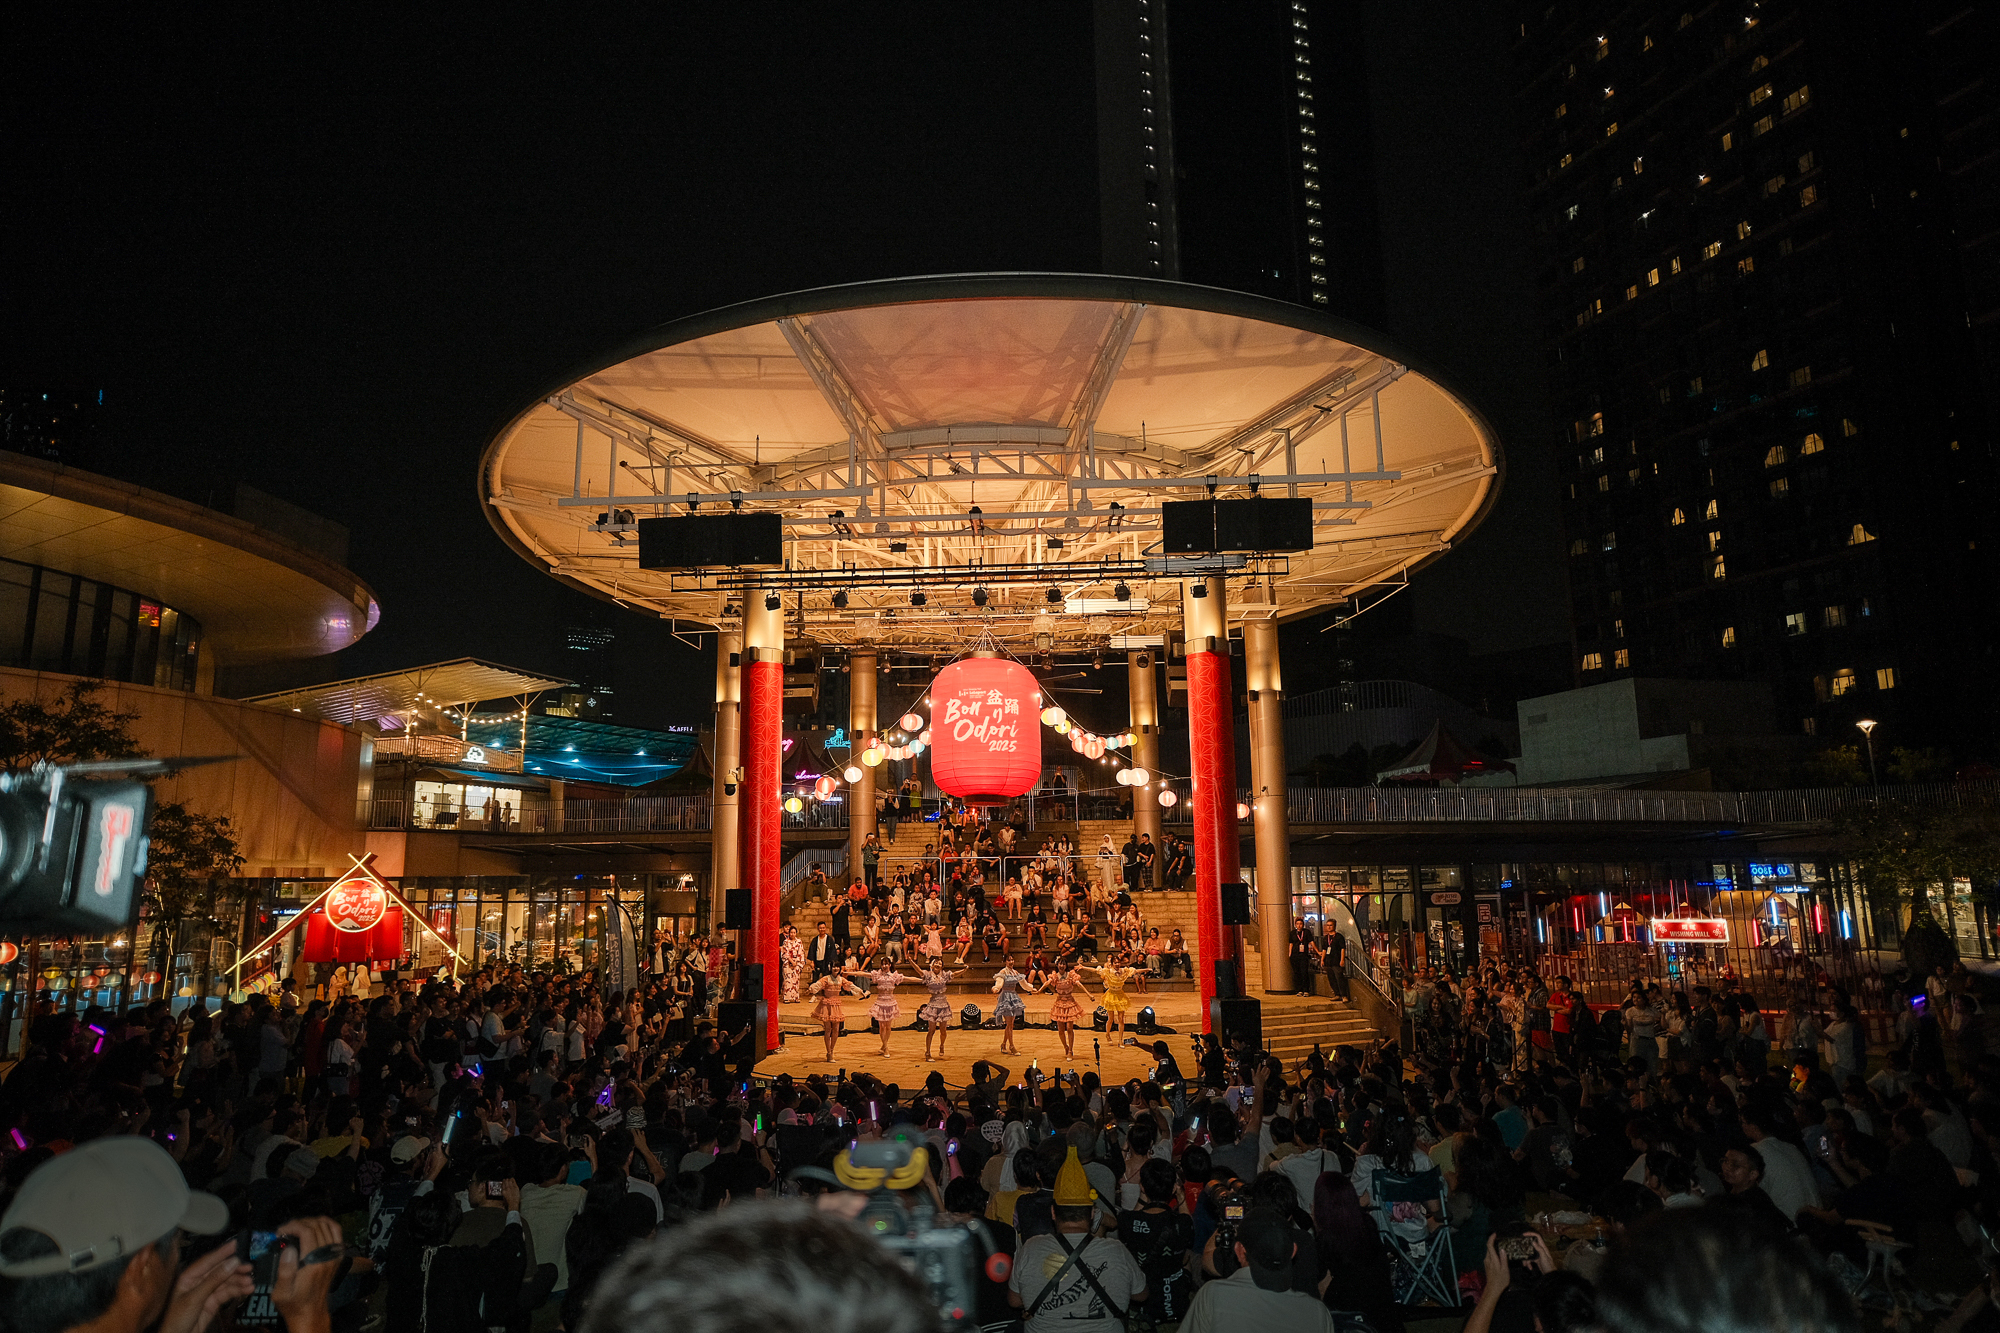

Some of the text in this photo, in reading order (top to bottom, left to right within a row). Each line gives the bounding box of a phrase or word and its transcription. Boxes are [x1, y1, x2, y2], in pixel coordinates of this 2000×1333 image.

[944, 698, 982, 725] Bon
[953, 716, 1019, 743] Odori
[989, 740, 1017, 752] 2025
[332, 891, 359, 905] Bon
[338, 903, 378, 917] Odori
[1132, 1226, 1151, 1234] SIC
[243, 1295, 279, 1317] EAL
[1163, 1278, 1174, 1317] FORWA
